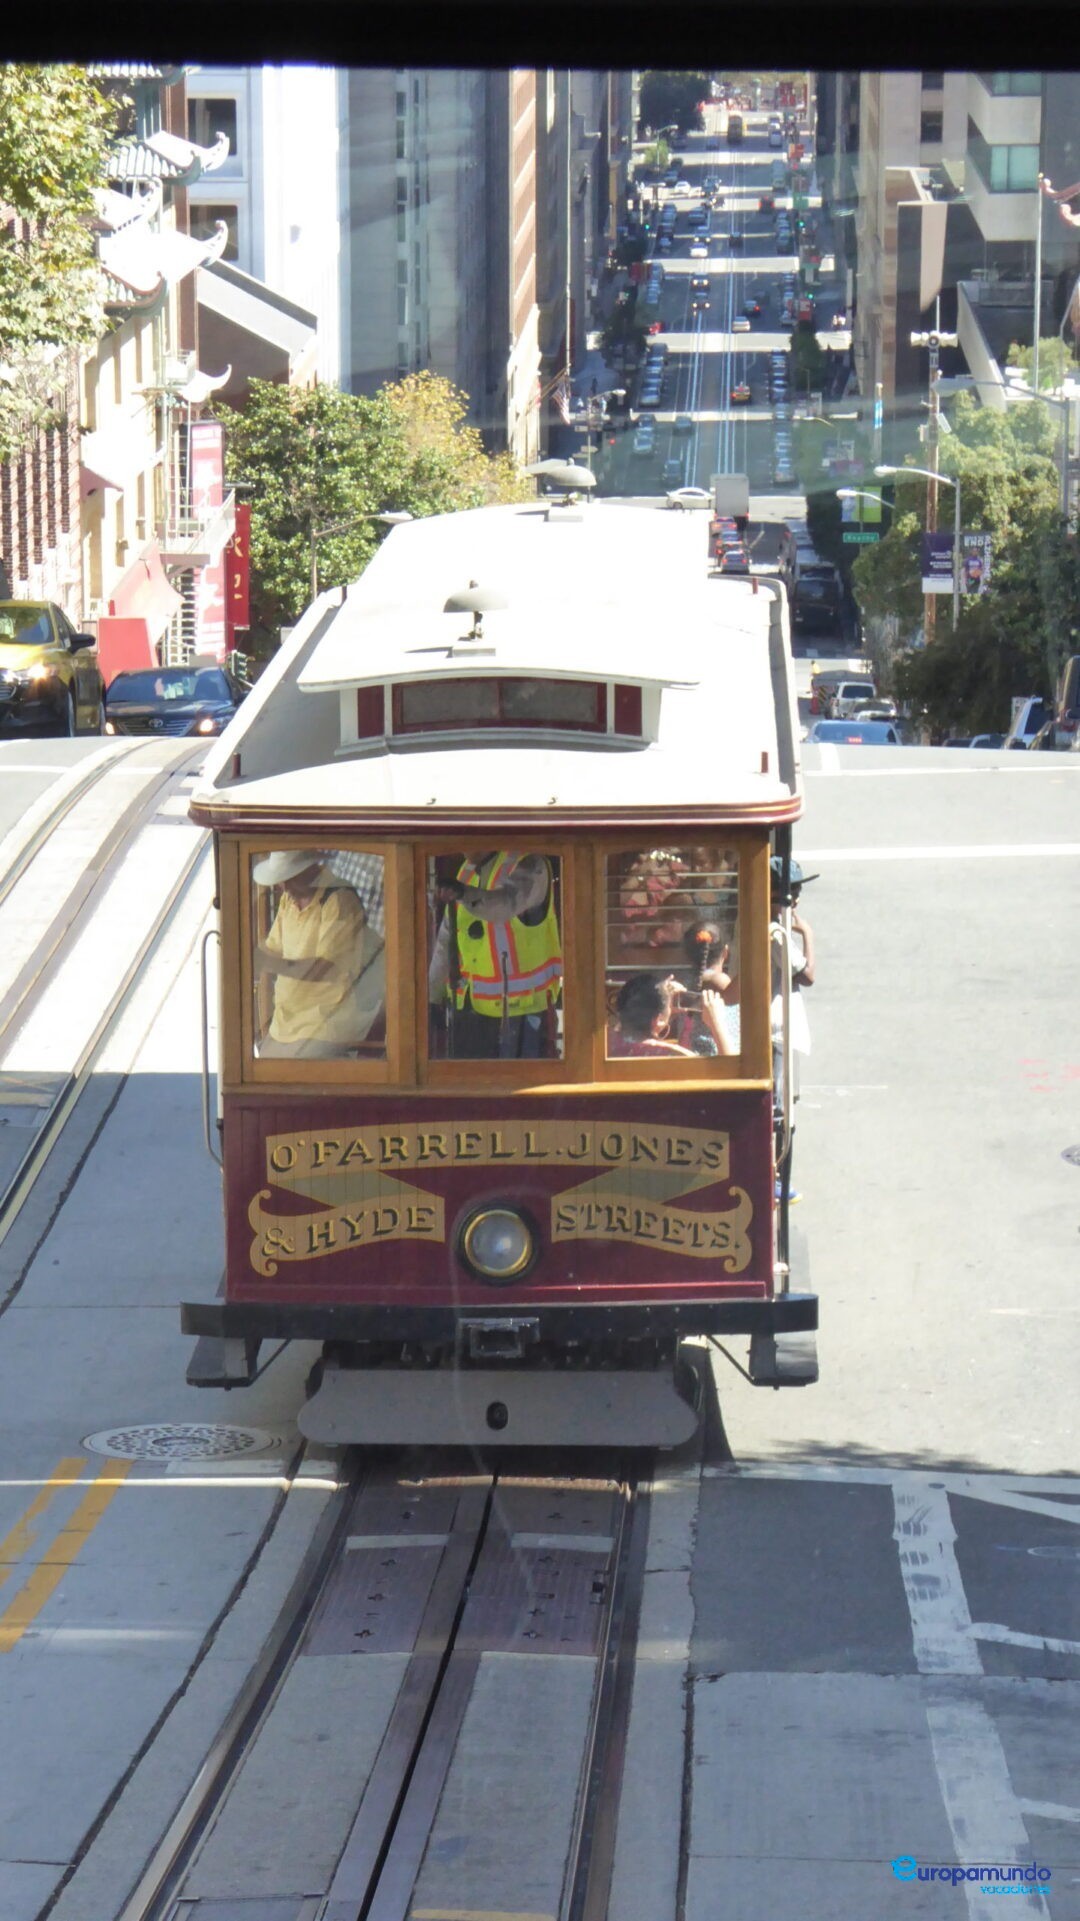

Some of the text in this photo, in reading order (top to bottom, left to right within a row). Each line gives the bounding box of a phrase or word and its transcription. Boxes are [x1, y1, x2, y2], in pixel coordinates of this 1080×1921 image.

[567, 1131, 724, 1169] JONES
[262, 1226, 297, 1257] &
[306, 1204, 436, 1254] HYDE
